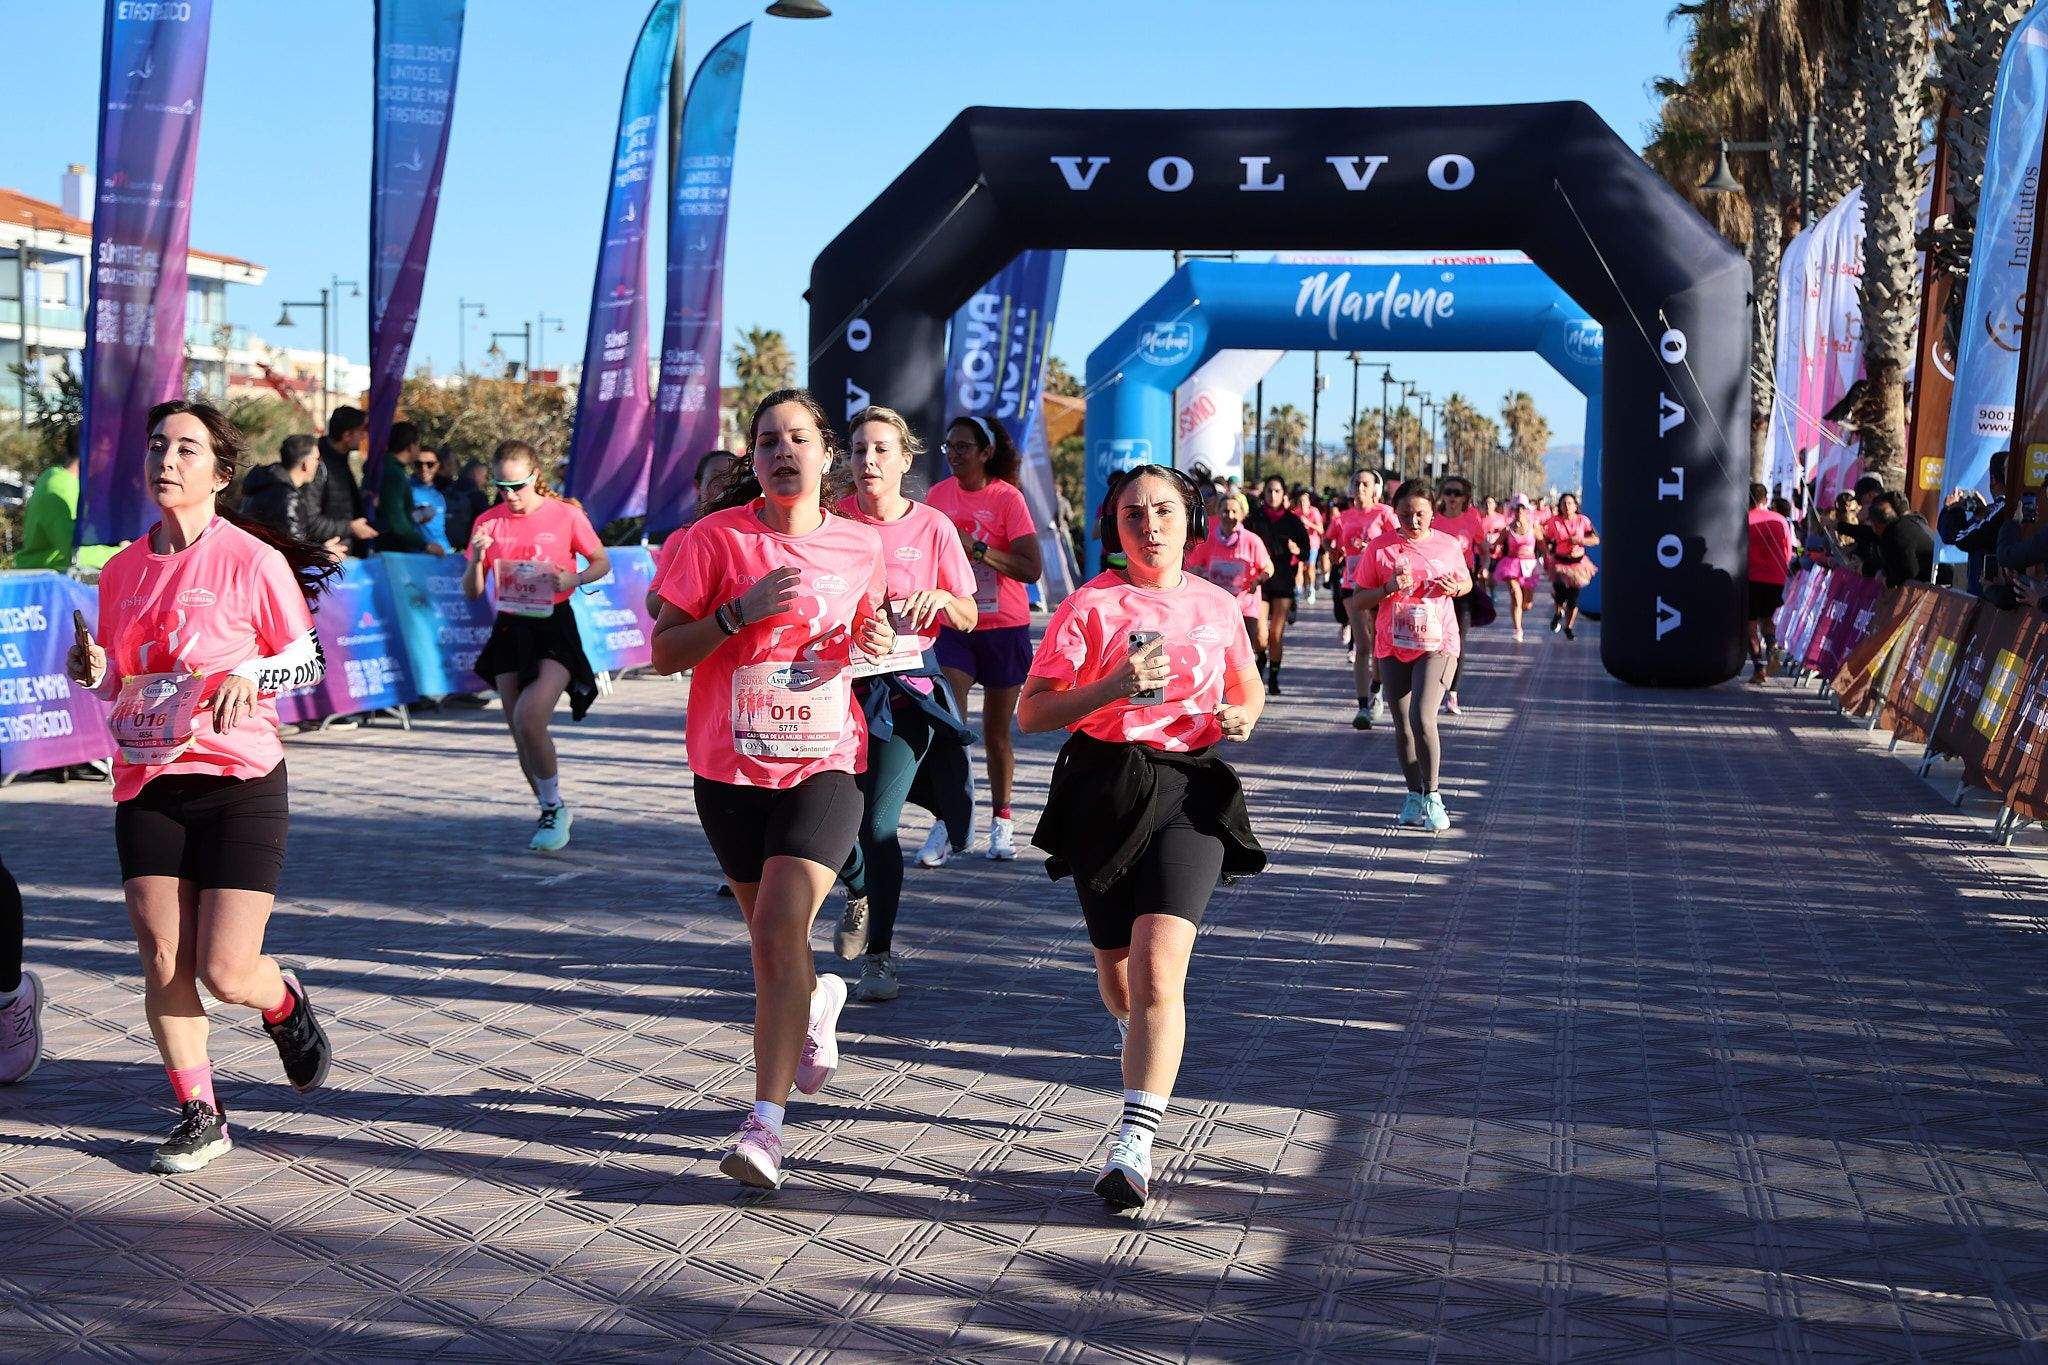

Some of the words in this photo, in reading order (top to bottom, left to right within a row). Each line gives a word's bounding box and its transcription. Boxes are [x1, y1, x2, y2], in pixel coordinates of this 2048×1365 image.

[1050, 154, 1475, 192] VOLVO
[2008, 166, 2038, 268] Institutos
[1295, 271, 1455, 341] Marlene
[1979, 409, 2004, 421] 900
[1656, 328, 1688, 641] VOLVO
[133, 712, 168, 728] 016
[770, 704, 812, 722] 016
[778, 724, 799, 732] 5775
[745, 742, 779, 752] OYSHO
